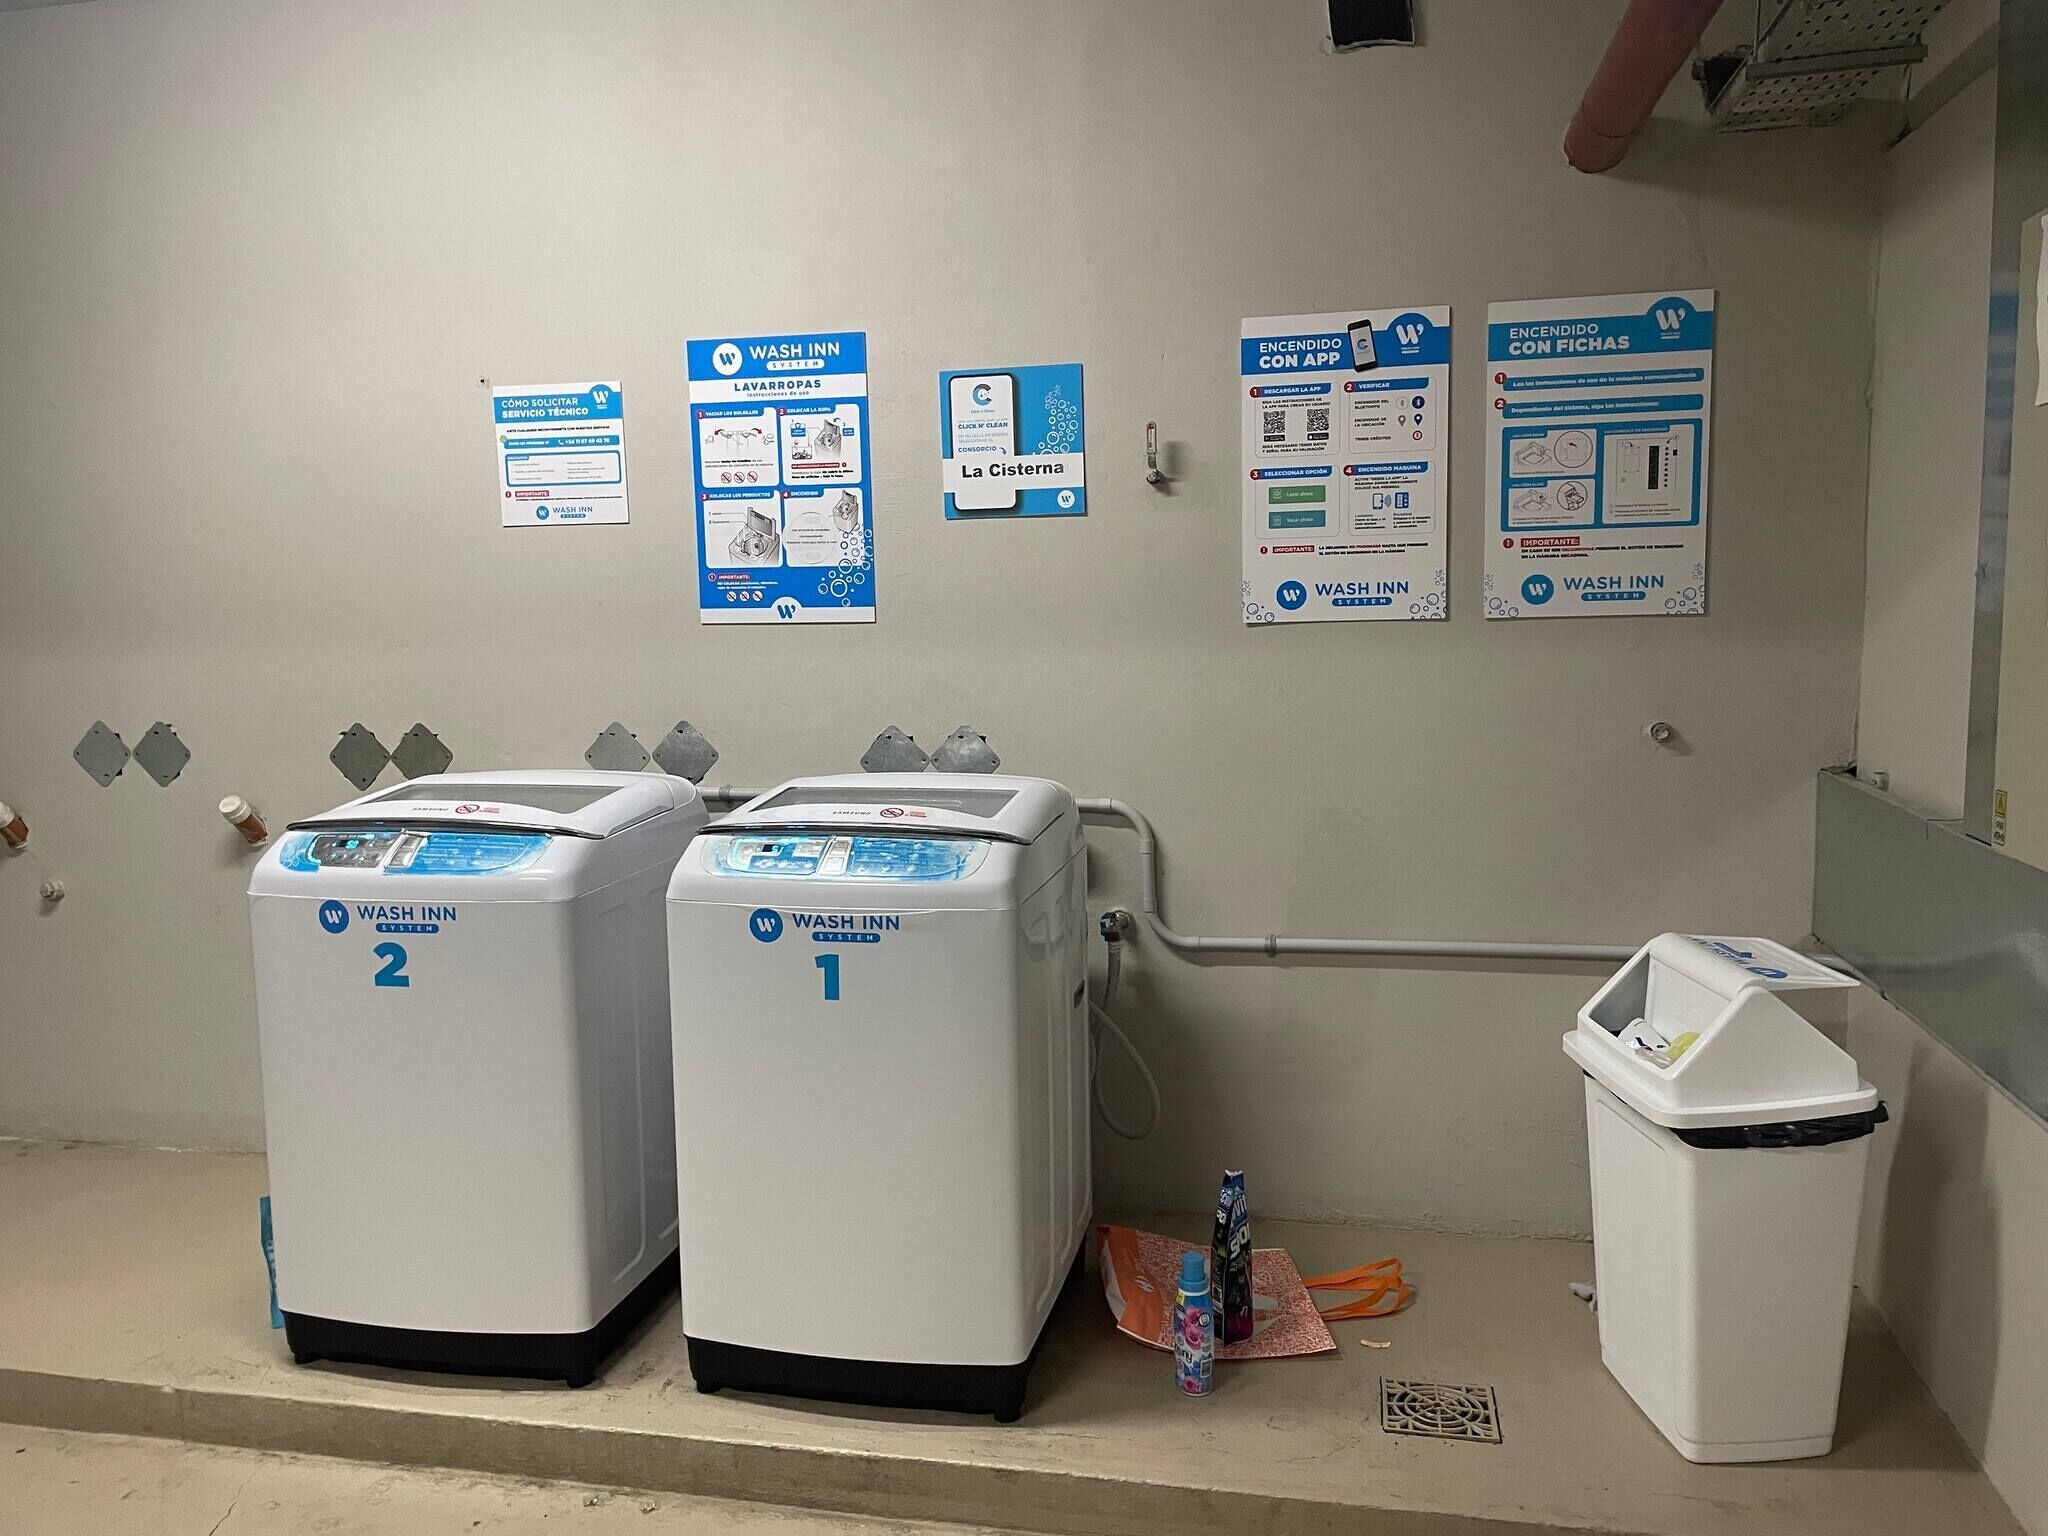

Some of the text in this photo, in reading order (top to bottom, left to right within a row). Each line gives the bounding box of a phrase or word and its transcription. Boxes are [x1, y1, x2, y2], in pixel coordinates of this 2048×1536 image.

[1510, 324, 1598, 339] ENCENDIDO
[750, 342, 840, 360] WASH INN
[1260, 339, 1342, 353] ENCENDIDO
[1509, 335, 1630, 355] CON FICHAS
[1260, 352, 1340, 368] CON APP
[734, 380, 821, 391] LAVARROPAS
[502, 398, 578, 408] CÓMO SOLICITAR
[1497, 400, 1504, 408] 2
[502, 408, 588, 418] SERVICIO TÉCNICO
[962, 463, 1064, 478] La Cisterna
[1523, 538, 1578, 546] IMPORTANTE:
[1315, 581, 1409, 596] WASH INN
[1564, 575, 1664, 590] WASH INN
[1588, 592, 1639, 600] SYSTEM
[357, 905, 456, 921] WASH INN
[792, 913, 900, 930] WASH INN
[373, 942, 410, 987] 2
[815, 954, 840, 1000] 1
